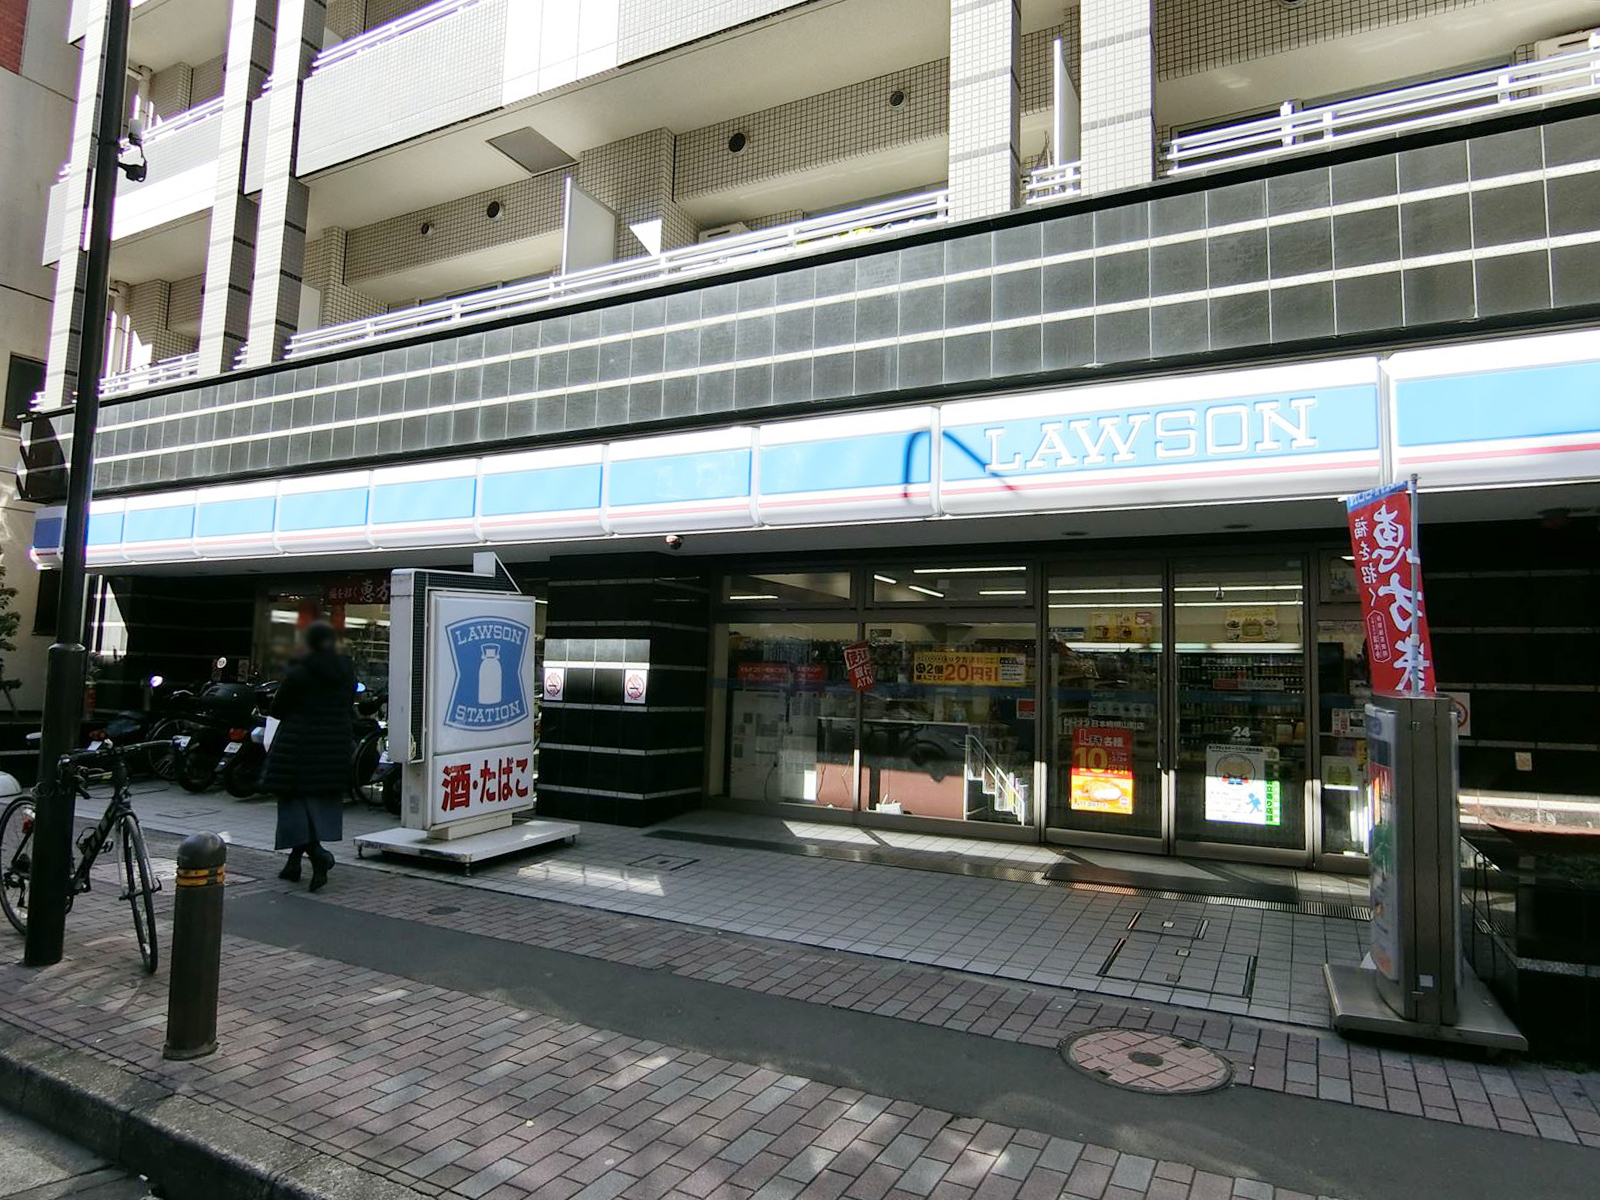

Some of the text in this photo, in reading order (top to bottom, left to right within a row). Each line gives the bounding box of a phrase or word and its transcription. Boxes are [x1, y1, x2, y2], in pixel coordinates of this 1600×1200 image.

[984, 396, 1319, 473] LAWSON
[455, 624, 523, 646] LAWSON
[944, 663, 998, 682] 20円引
[455, 699, 521, 723] STATION
[1232, 725, 1251, 738] 24
[441, 757, 529, 812] 酒・たばこ
